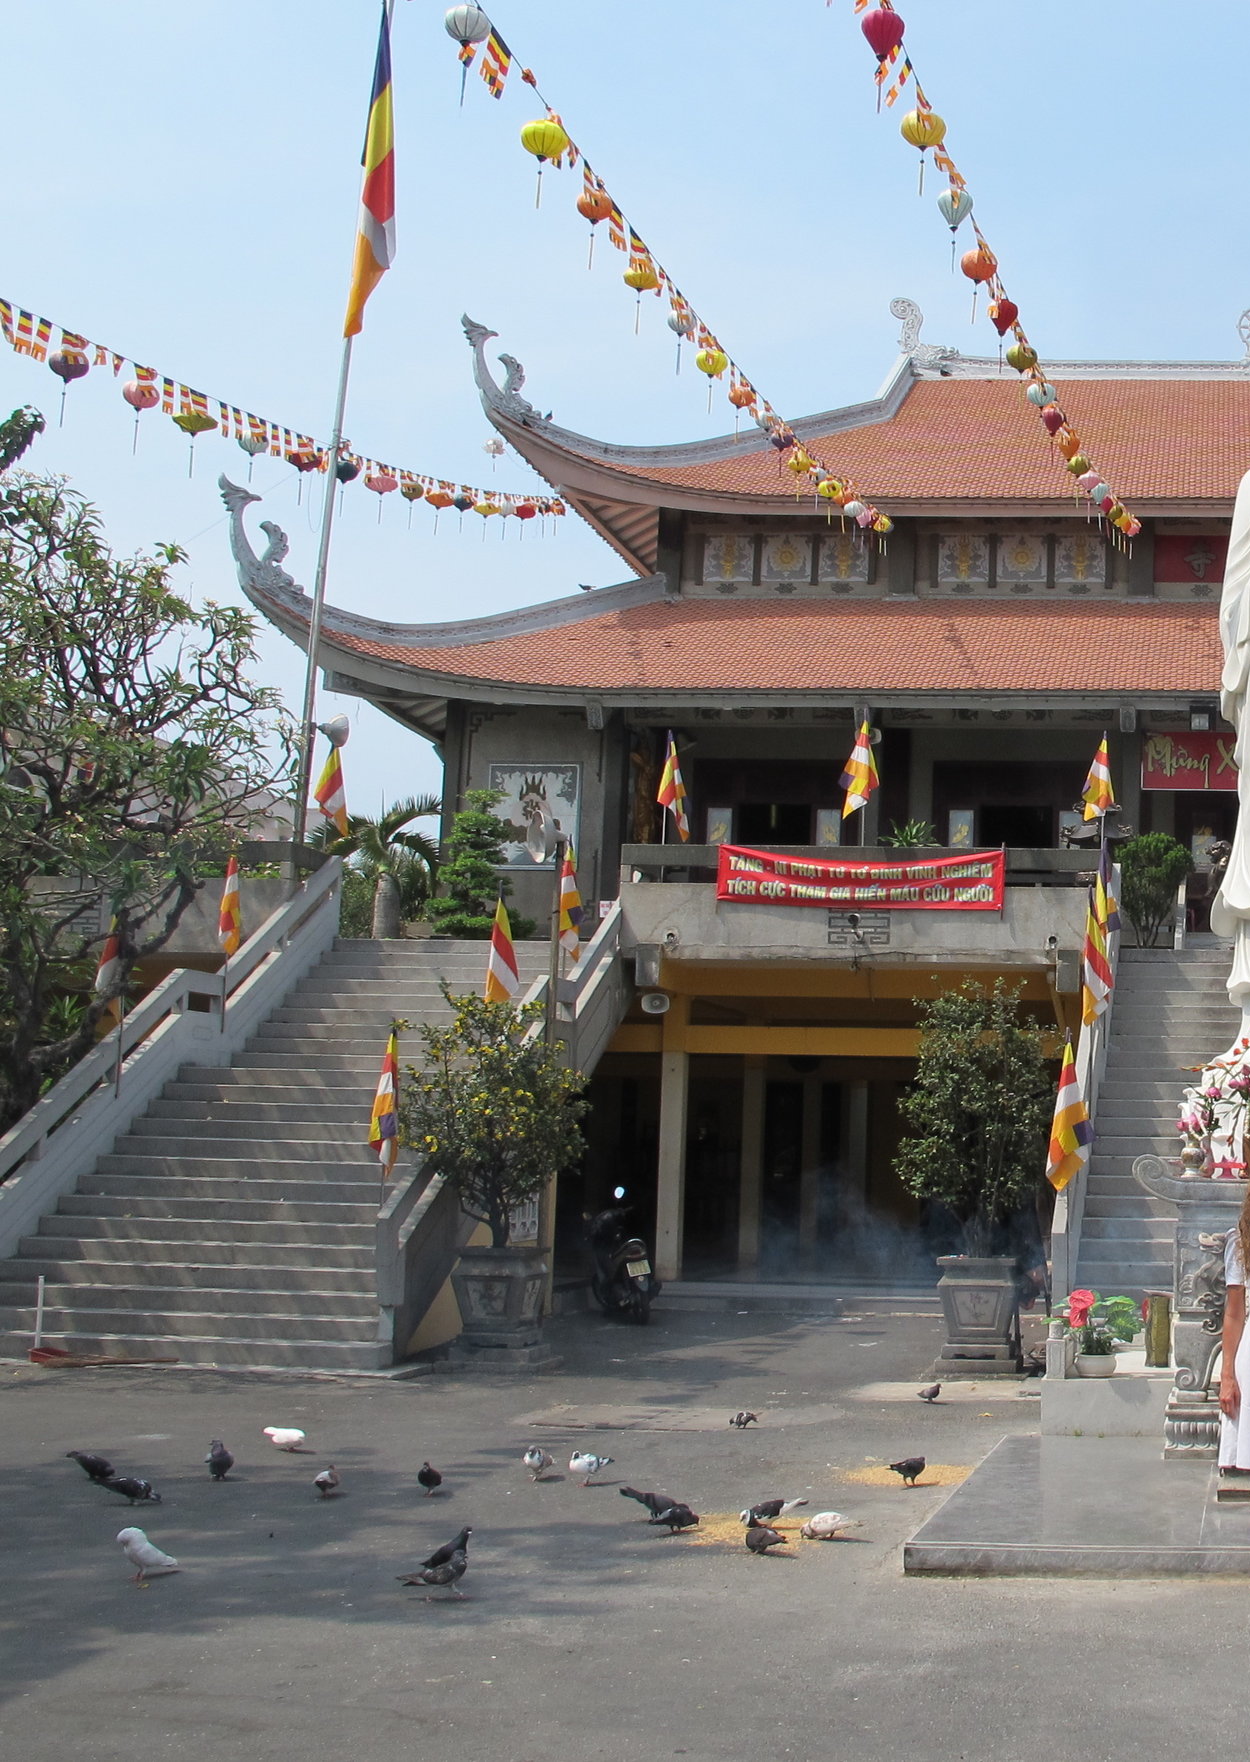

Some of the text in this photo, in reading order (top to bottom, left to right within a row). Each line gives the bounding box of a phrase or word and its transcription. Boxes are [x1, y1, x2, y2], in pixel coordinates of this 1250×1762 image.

[774, 861, 787, 875] NI
[789, 884, 826, 899] THAM
[829, 887, 851, 900] GIA
